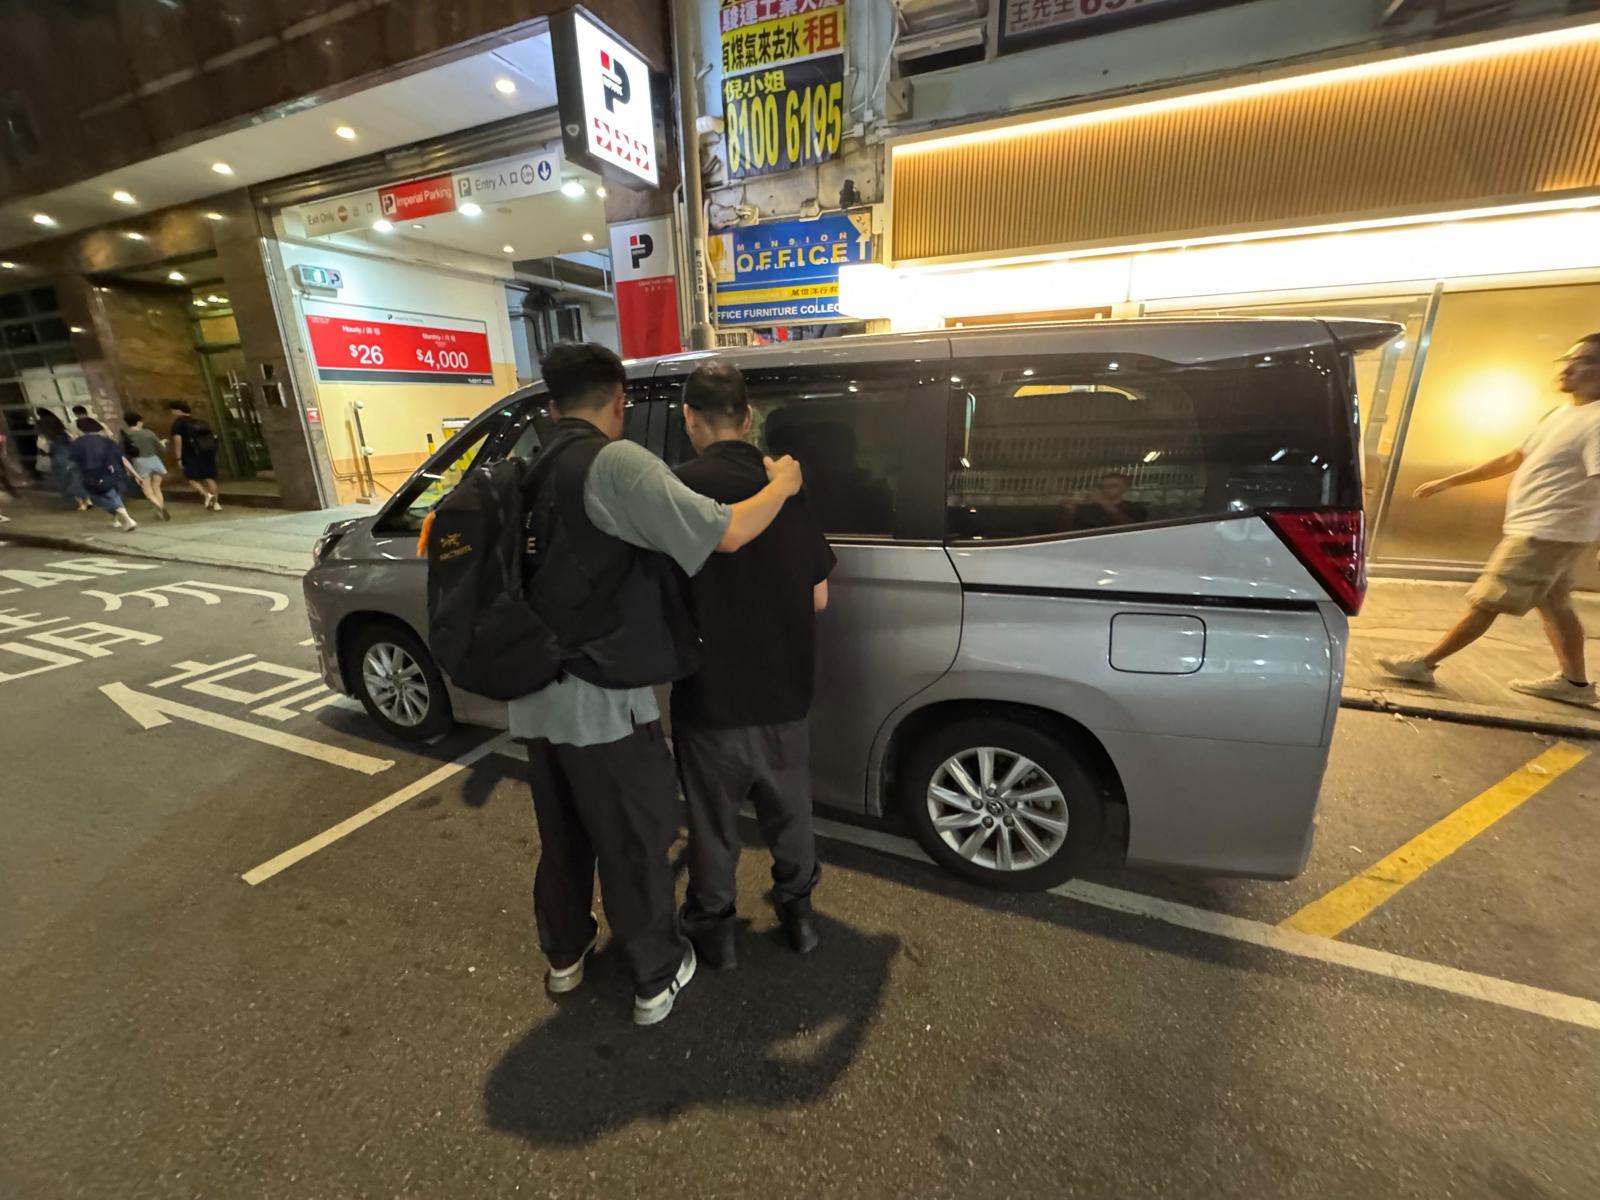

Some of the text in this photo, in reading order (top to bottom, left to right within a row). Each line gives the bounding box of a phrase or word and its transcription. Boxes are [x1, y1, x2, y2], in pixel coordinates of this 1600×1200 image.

[1010, 0, 1074, 24] 王先生
[803, 11, 841, 54] 租
[724, 69, 786, 103] 倪小姐
[726, 93, 779, 174] 8100
[785, 81, 842, 163] 6195
[475, 177, 497, 191] Entry
[397, 191, 424, 208] Imperial
[424, 187, 452, 202] Parking
[307, 214, 320, 225] Exit
[319, 210, 335, 224] Only
[737, 243, 848, 273] OFFICE
[743, 306, 798, 318] FURNITURE
[349, 343, 385, 365] $26
[416, 348, 469, 370] $4,000
